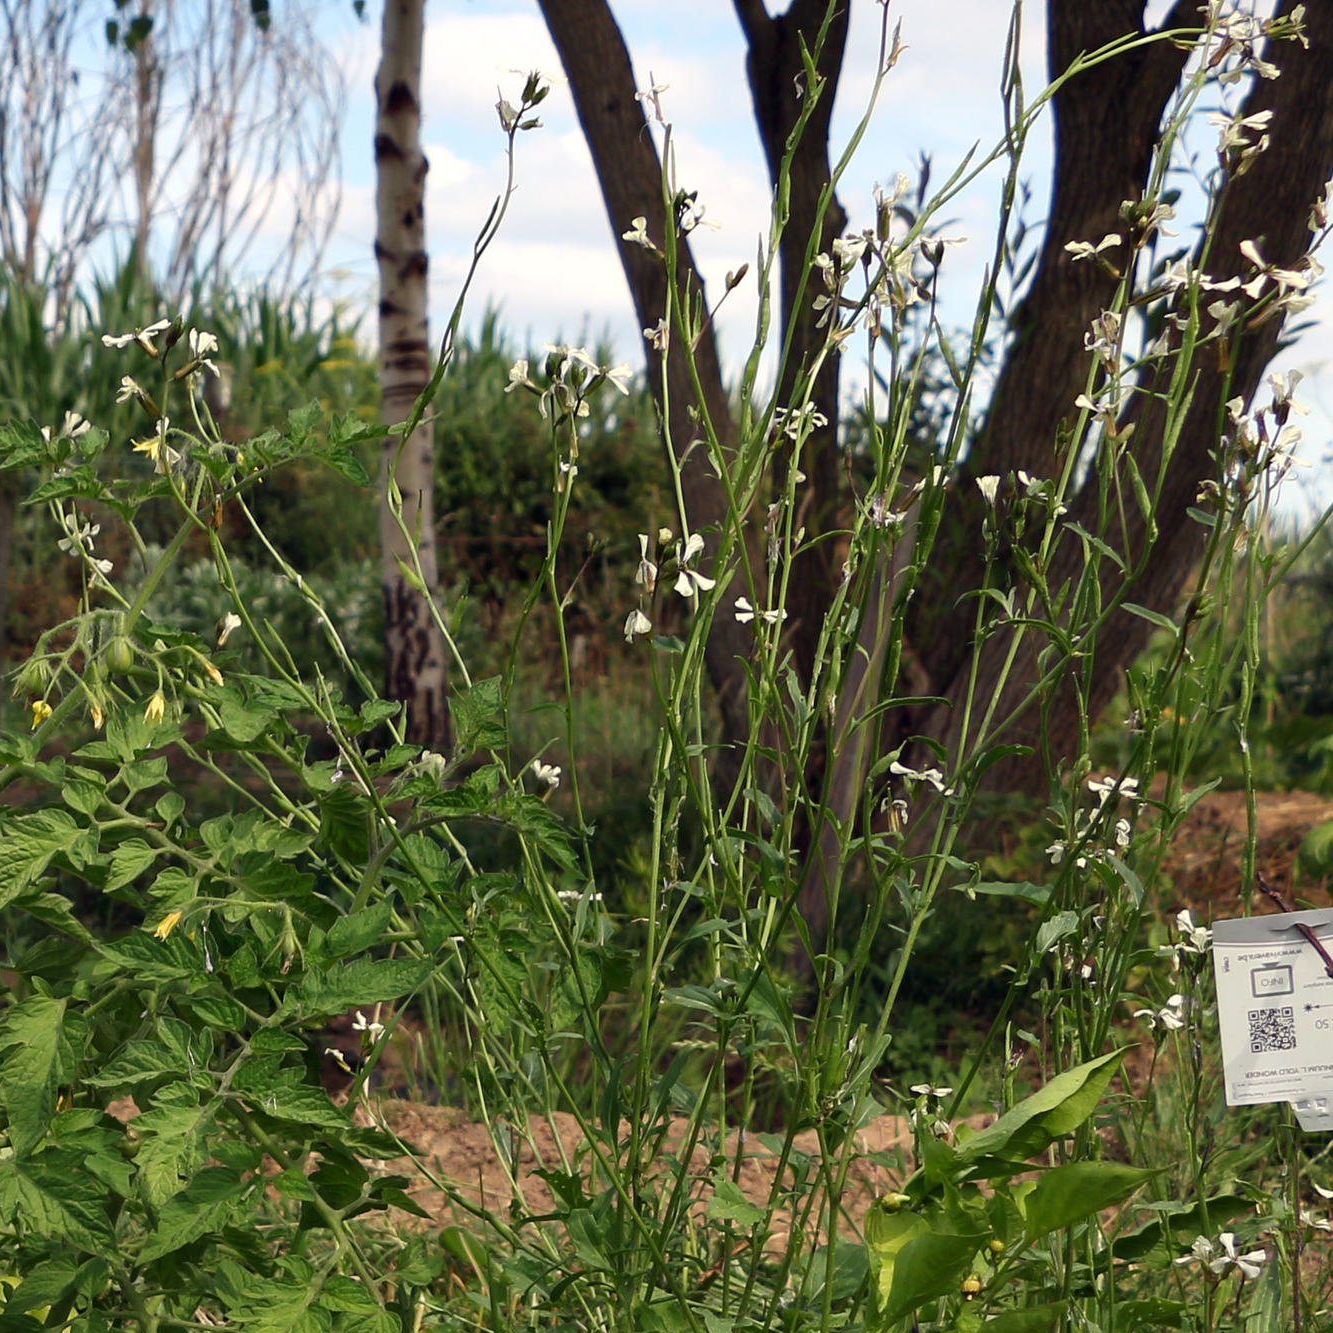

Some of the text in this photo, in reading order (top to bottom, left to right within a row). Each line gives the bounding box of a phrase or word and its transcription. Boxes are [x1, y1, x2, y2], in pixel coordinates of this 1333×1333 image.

[1261, 977, 1284, 987] INFO
[1315, 1018, 1329, 1030] 50
[1245, 1069, 1278, 1079] WONDER
[1279, 1067, 1298, 1076] YOLO
